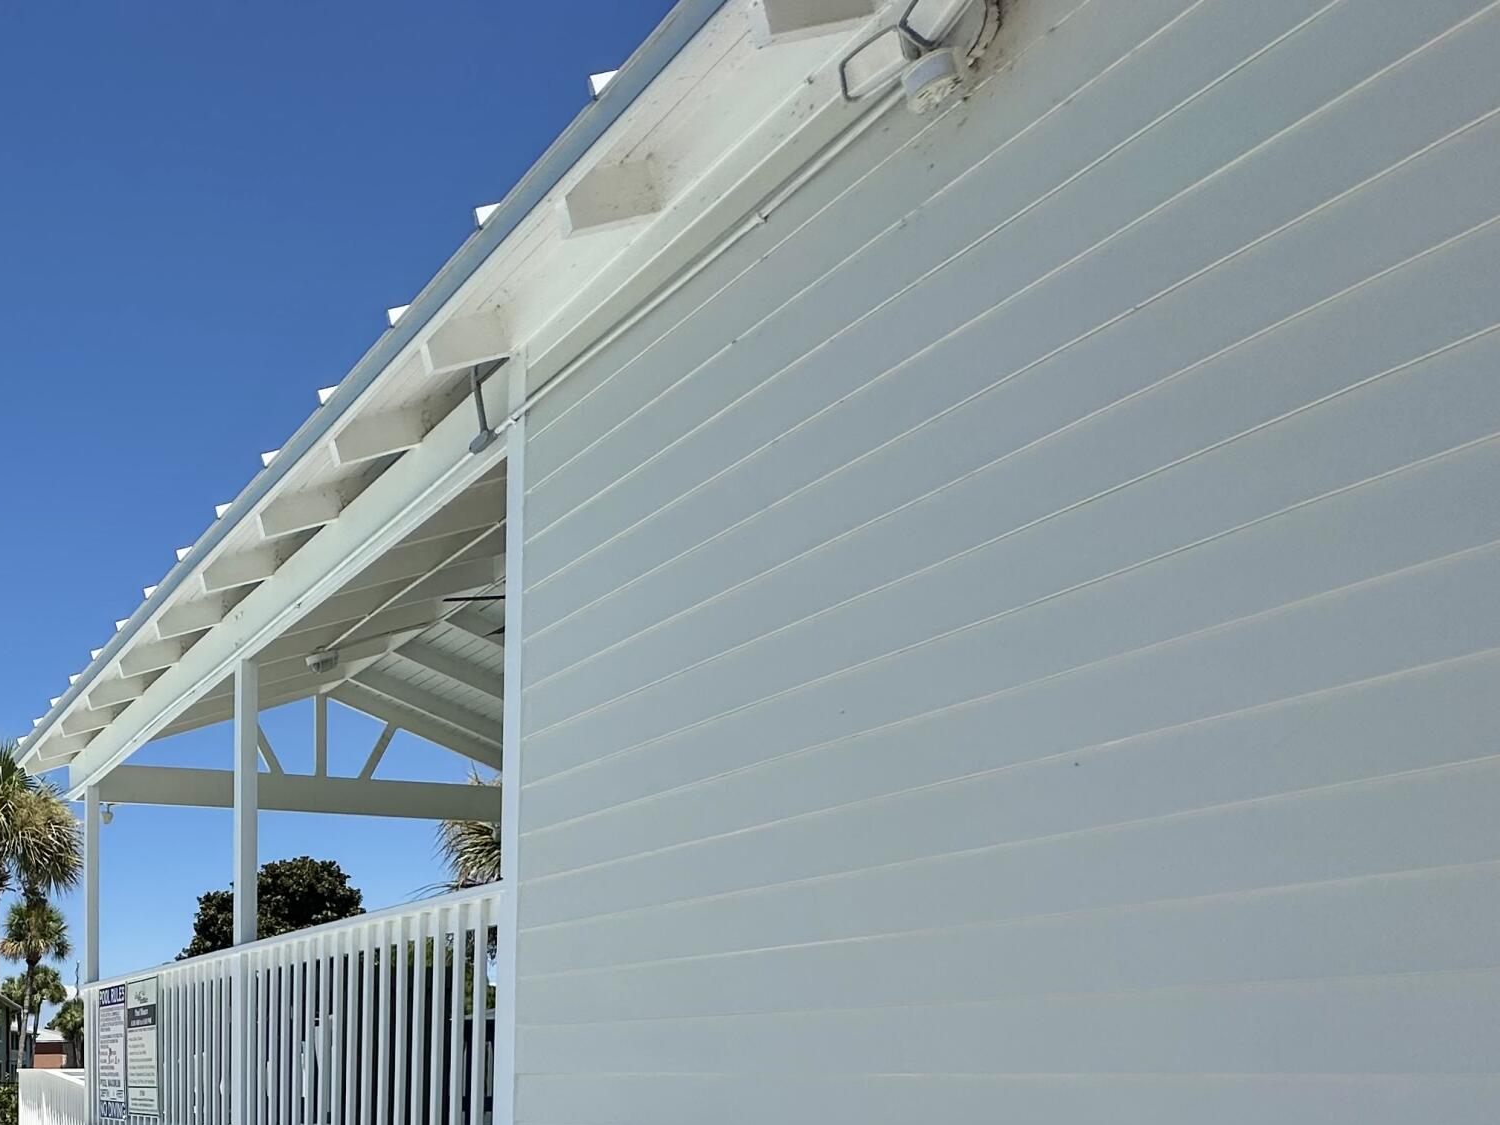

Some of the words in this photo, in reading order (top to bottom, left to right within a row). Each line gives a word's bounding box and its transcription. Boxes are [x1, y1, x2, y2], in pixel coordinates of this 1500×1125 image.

[99, 989, 110, 1005] POOL
[111, 986, 125, 1003] RULES
[100, 1101, 108, 1116] NO
[108, 1102, 126, 1119] DIVING
